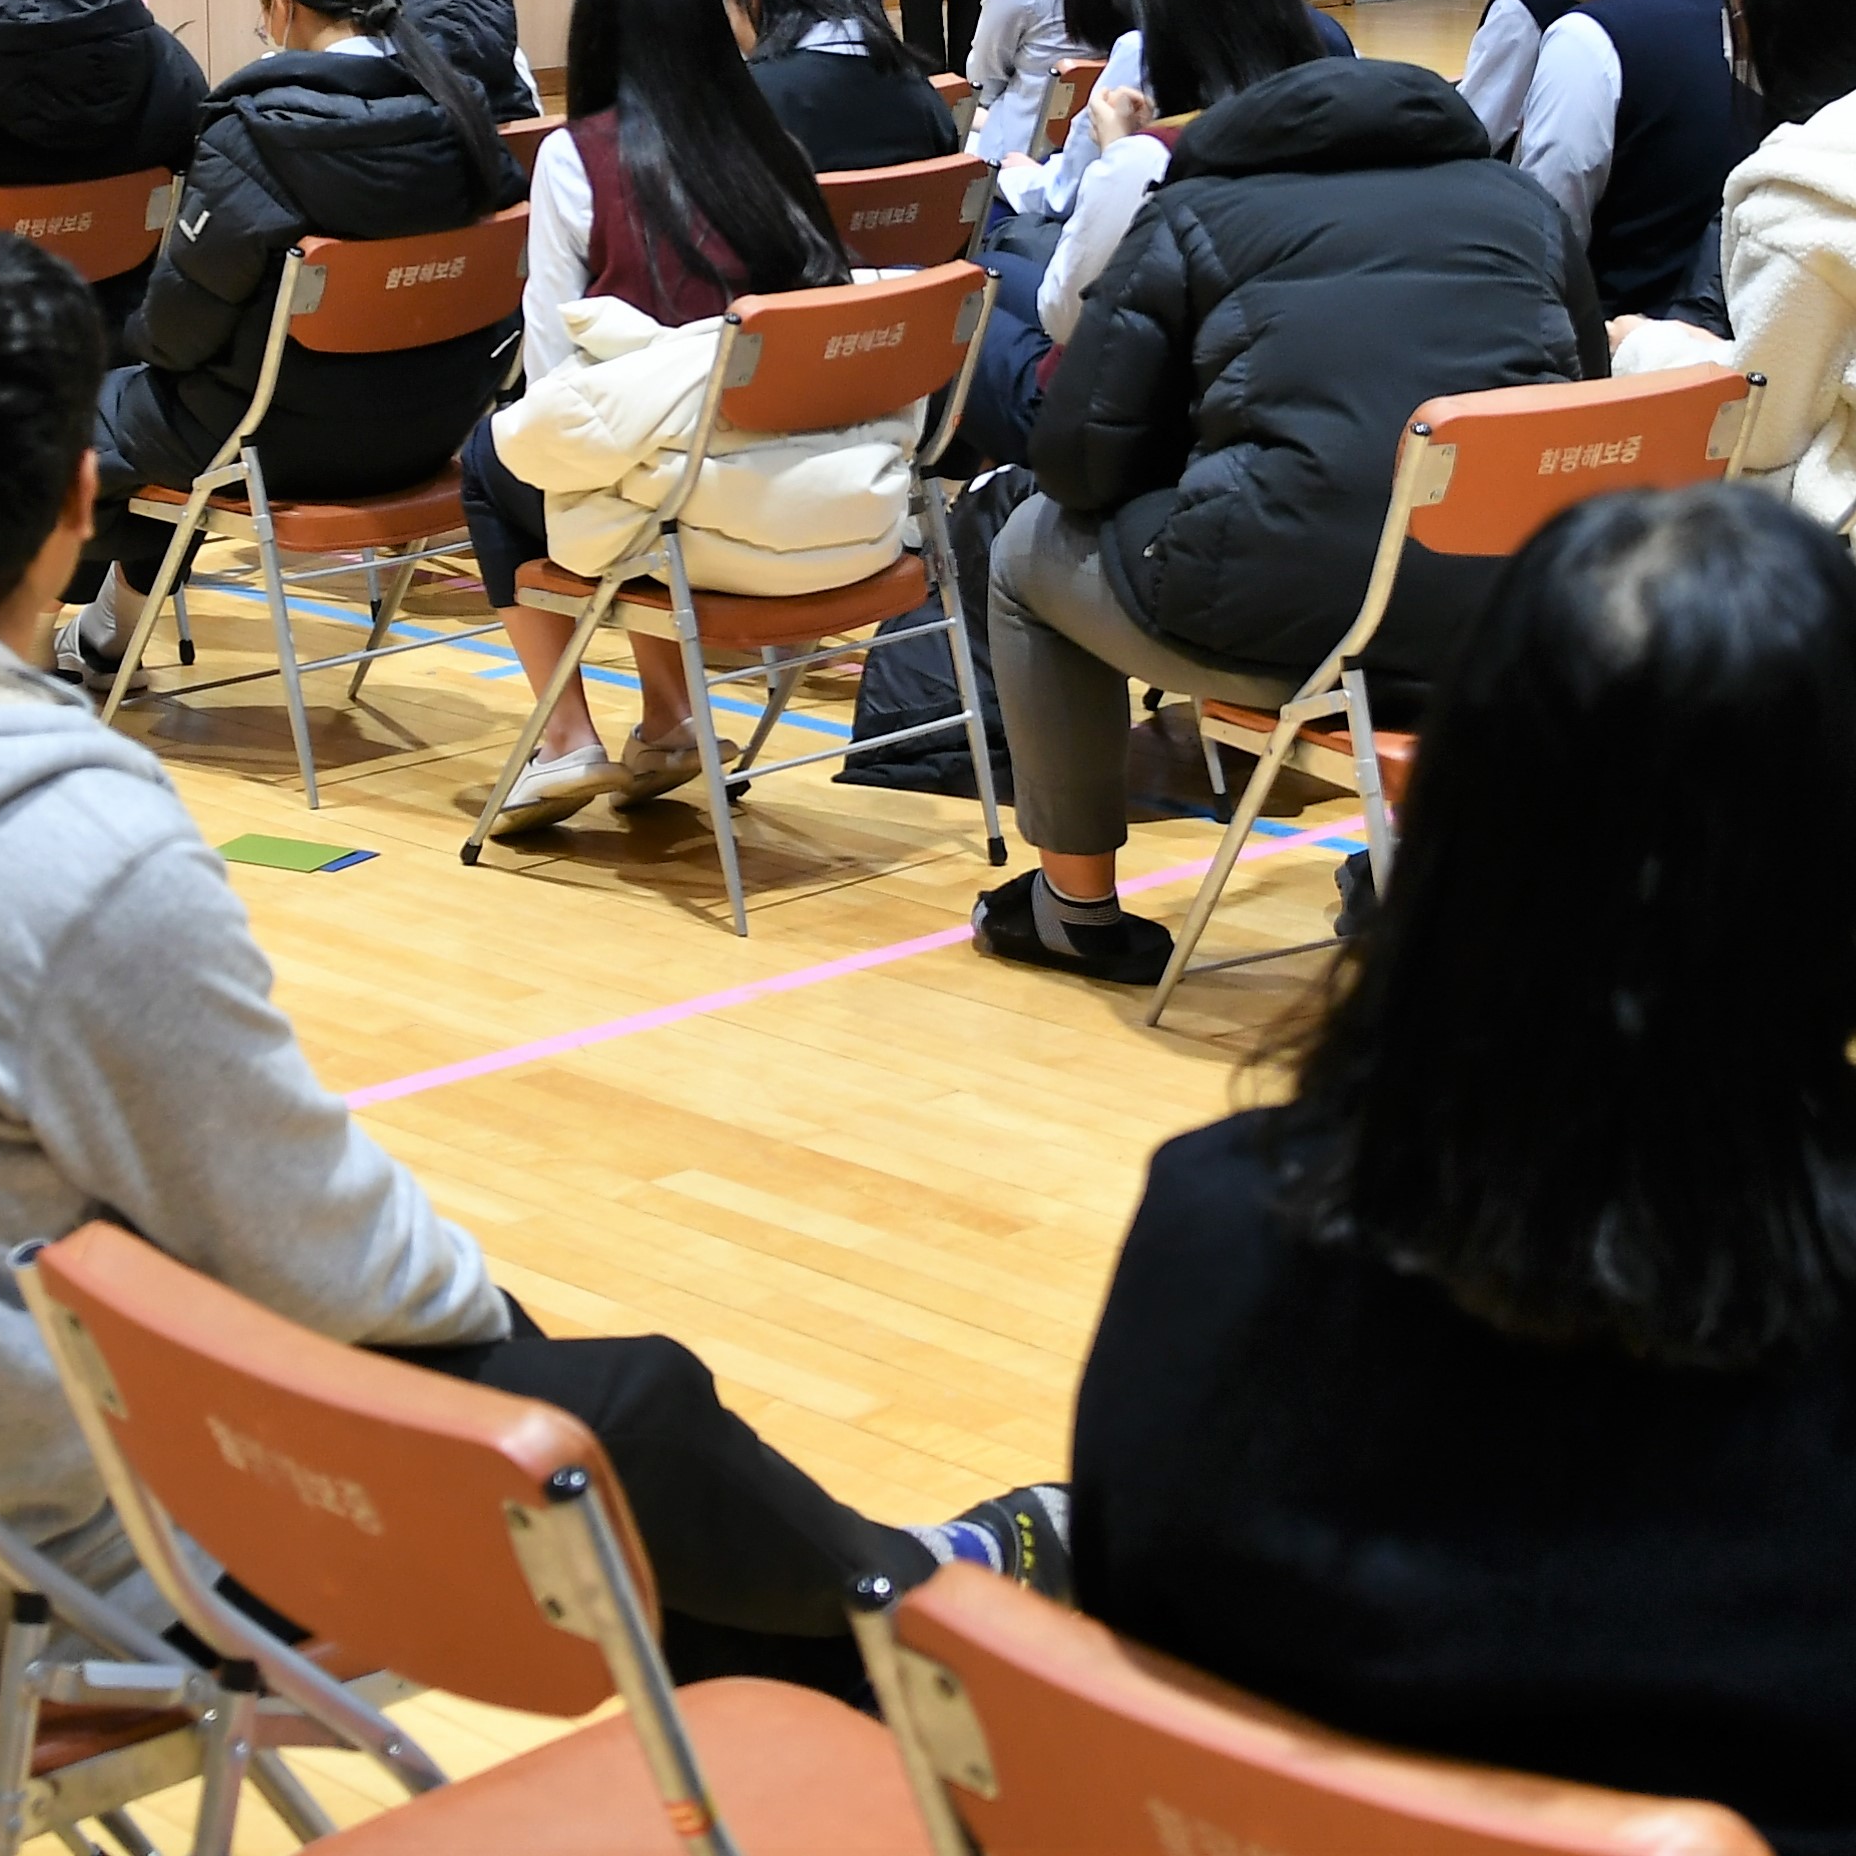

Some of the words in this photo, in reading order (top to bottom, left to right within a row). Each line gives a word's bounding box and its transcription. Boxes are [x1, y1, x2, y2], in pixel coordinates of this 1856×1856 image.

[14, 211, 93, 239] 함평해보중
[385, 256, 466, 290] 함평해보중
[824, 321, 906, 360] 함평해보중
[1537, 434, 1644, 475] 함평해보중
